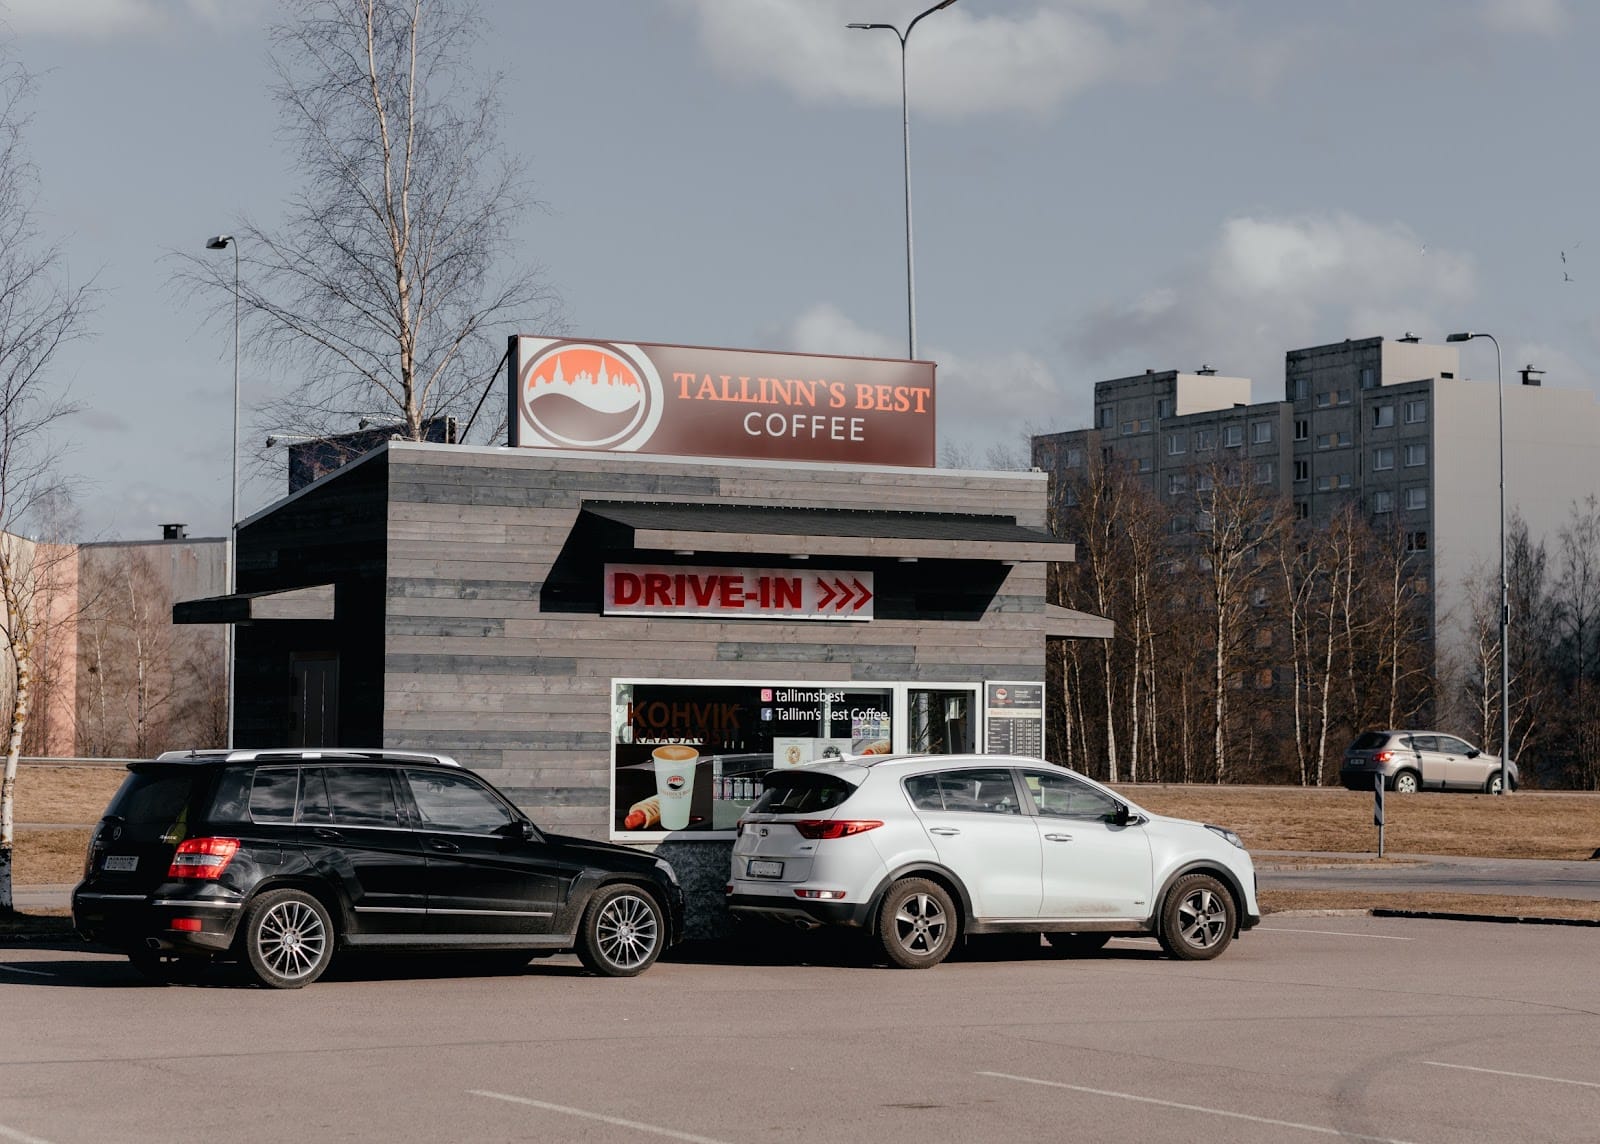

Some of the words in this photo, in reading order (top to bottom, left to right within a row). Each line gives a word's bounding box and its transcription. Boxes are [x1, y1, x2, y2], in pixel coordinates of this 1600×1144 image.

[854, 383, 931, 413] BEST
[743, 411, 865, 441] COFFEE
[613, 572, 802, 609] DRIVE-IN
[775, 689, 846, 703] tallinnsbest
[627, 700, 742, 729] KOHVIK
[775, 708, 821, 721] Tallinn's
